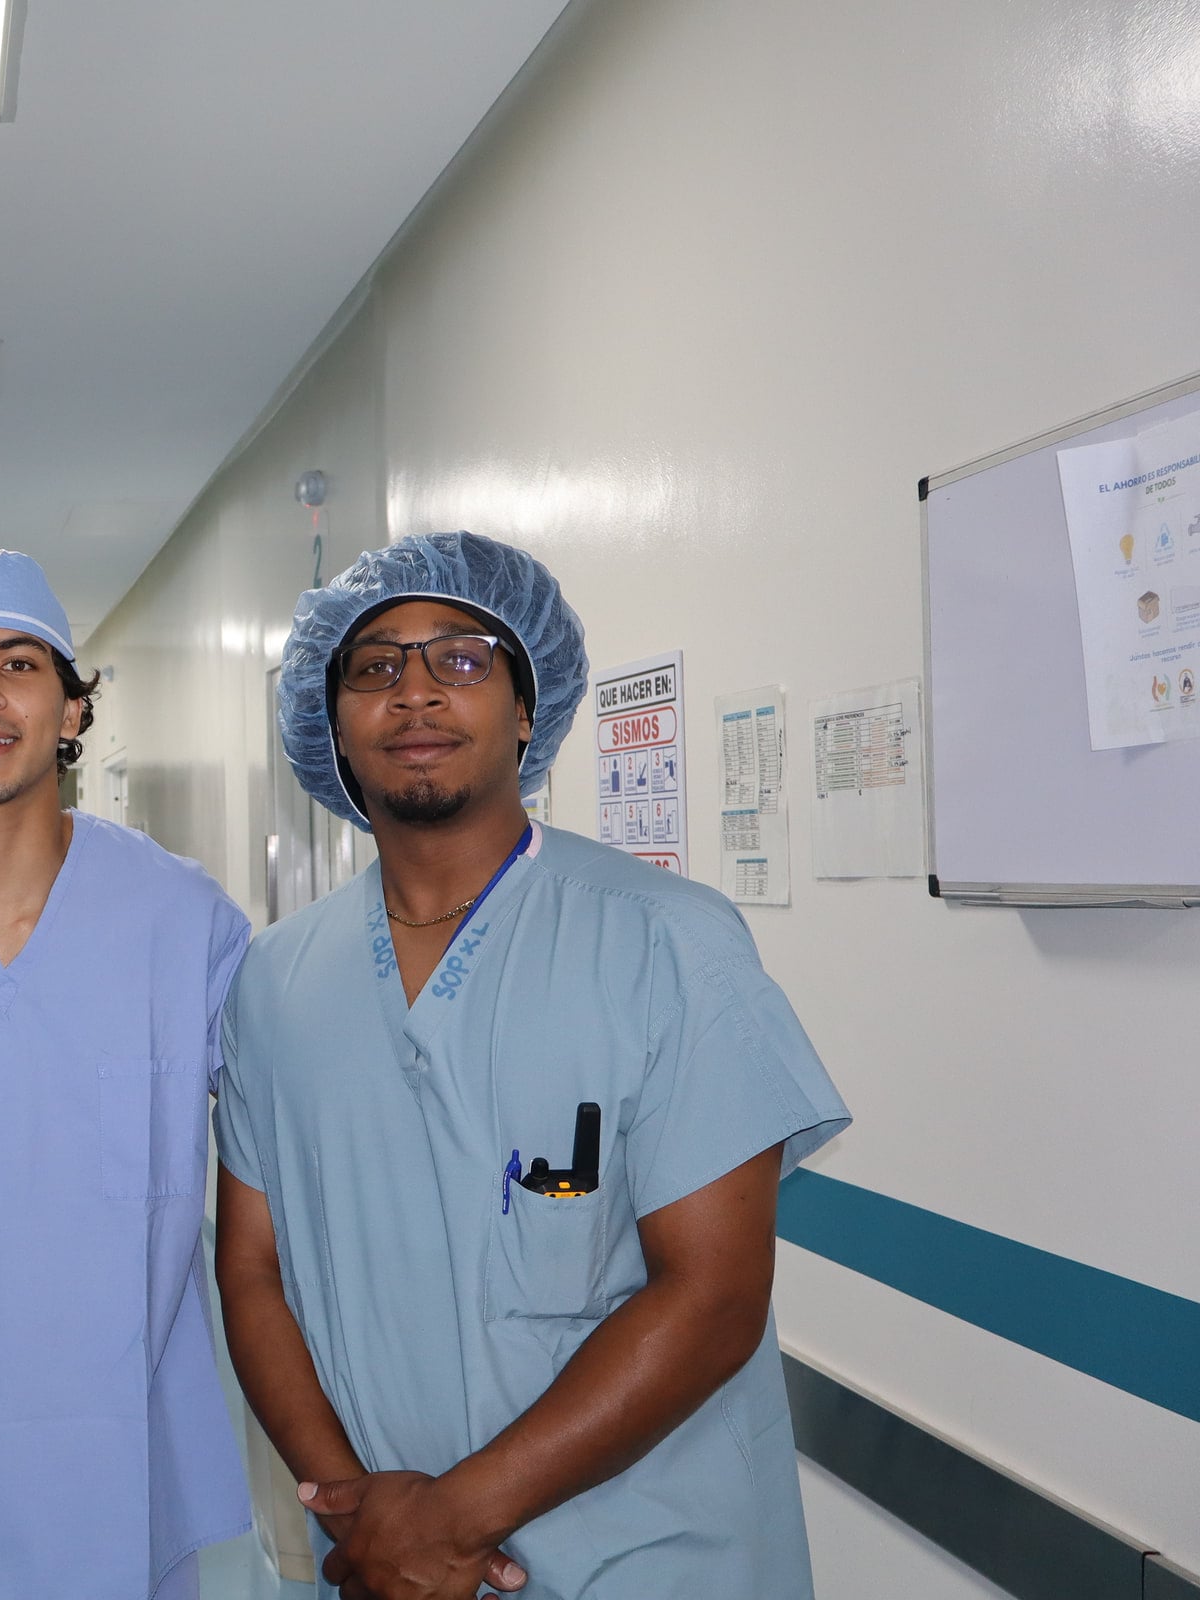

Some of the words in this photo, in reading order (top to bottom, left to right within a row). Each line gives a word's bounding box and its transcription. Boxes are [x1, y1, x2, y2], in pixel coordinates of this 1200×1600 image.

[1099, 484, 1111, 493] EL
[1113, 474, 1147, 491] AHORRO
[1147, 470, 1156, 481] ES
[1145, 484, 1154, 495] DE
[1154, 476, 1177, 491] TODOS
[313, 534, 322, 589] 2
[600, 687, 618, 708] QUE
[620, 678, 653, 704] HACER
[655, 674, 672, 696] EN:
[612, 714, 660, 746] SISMOS
[603, 760, 607, 773] 1
[627, 756, 632, 770] 2
[655, 752, 660, 766] 3
[603, 807, 608, 820] 4
[628, 805, 634, 819] 5
[656, 803, 662, 817] 6
[373, 936, 396, 979] SOP
[431, 955, 470, 1001] SOP
[459, 922, 490, 956] XL
